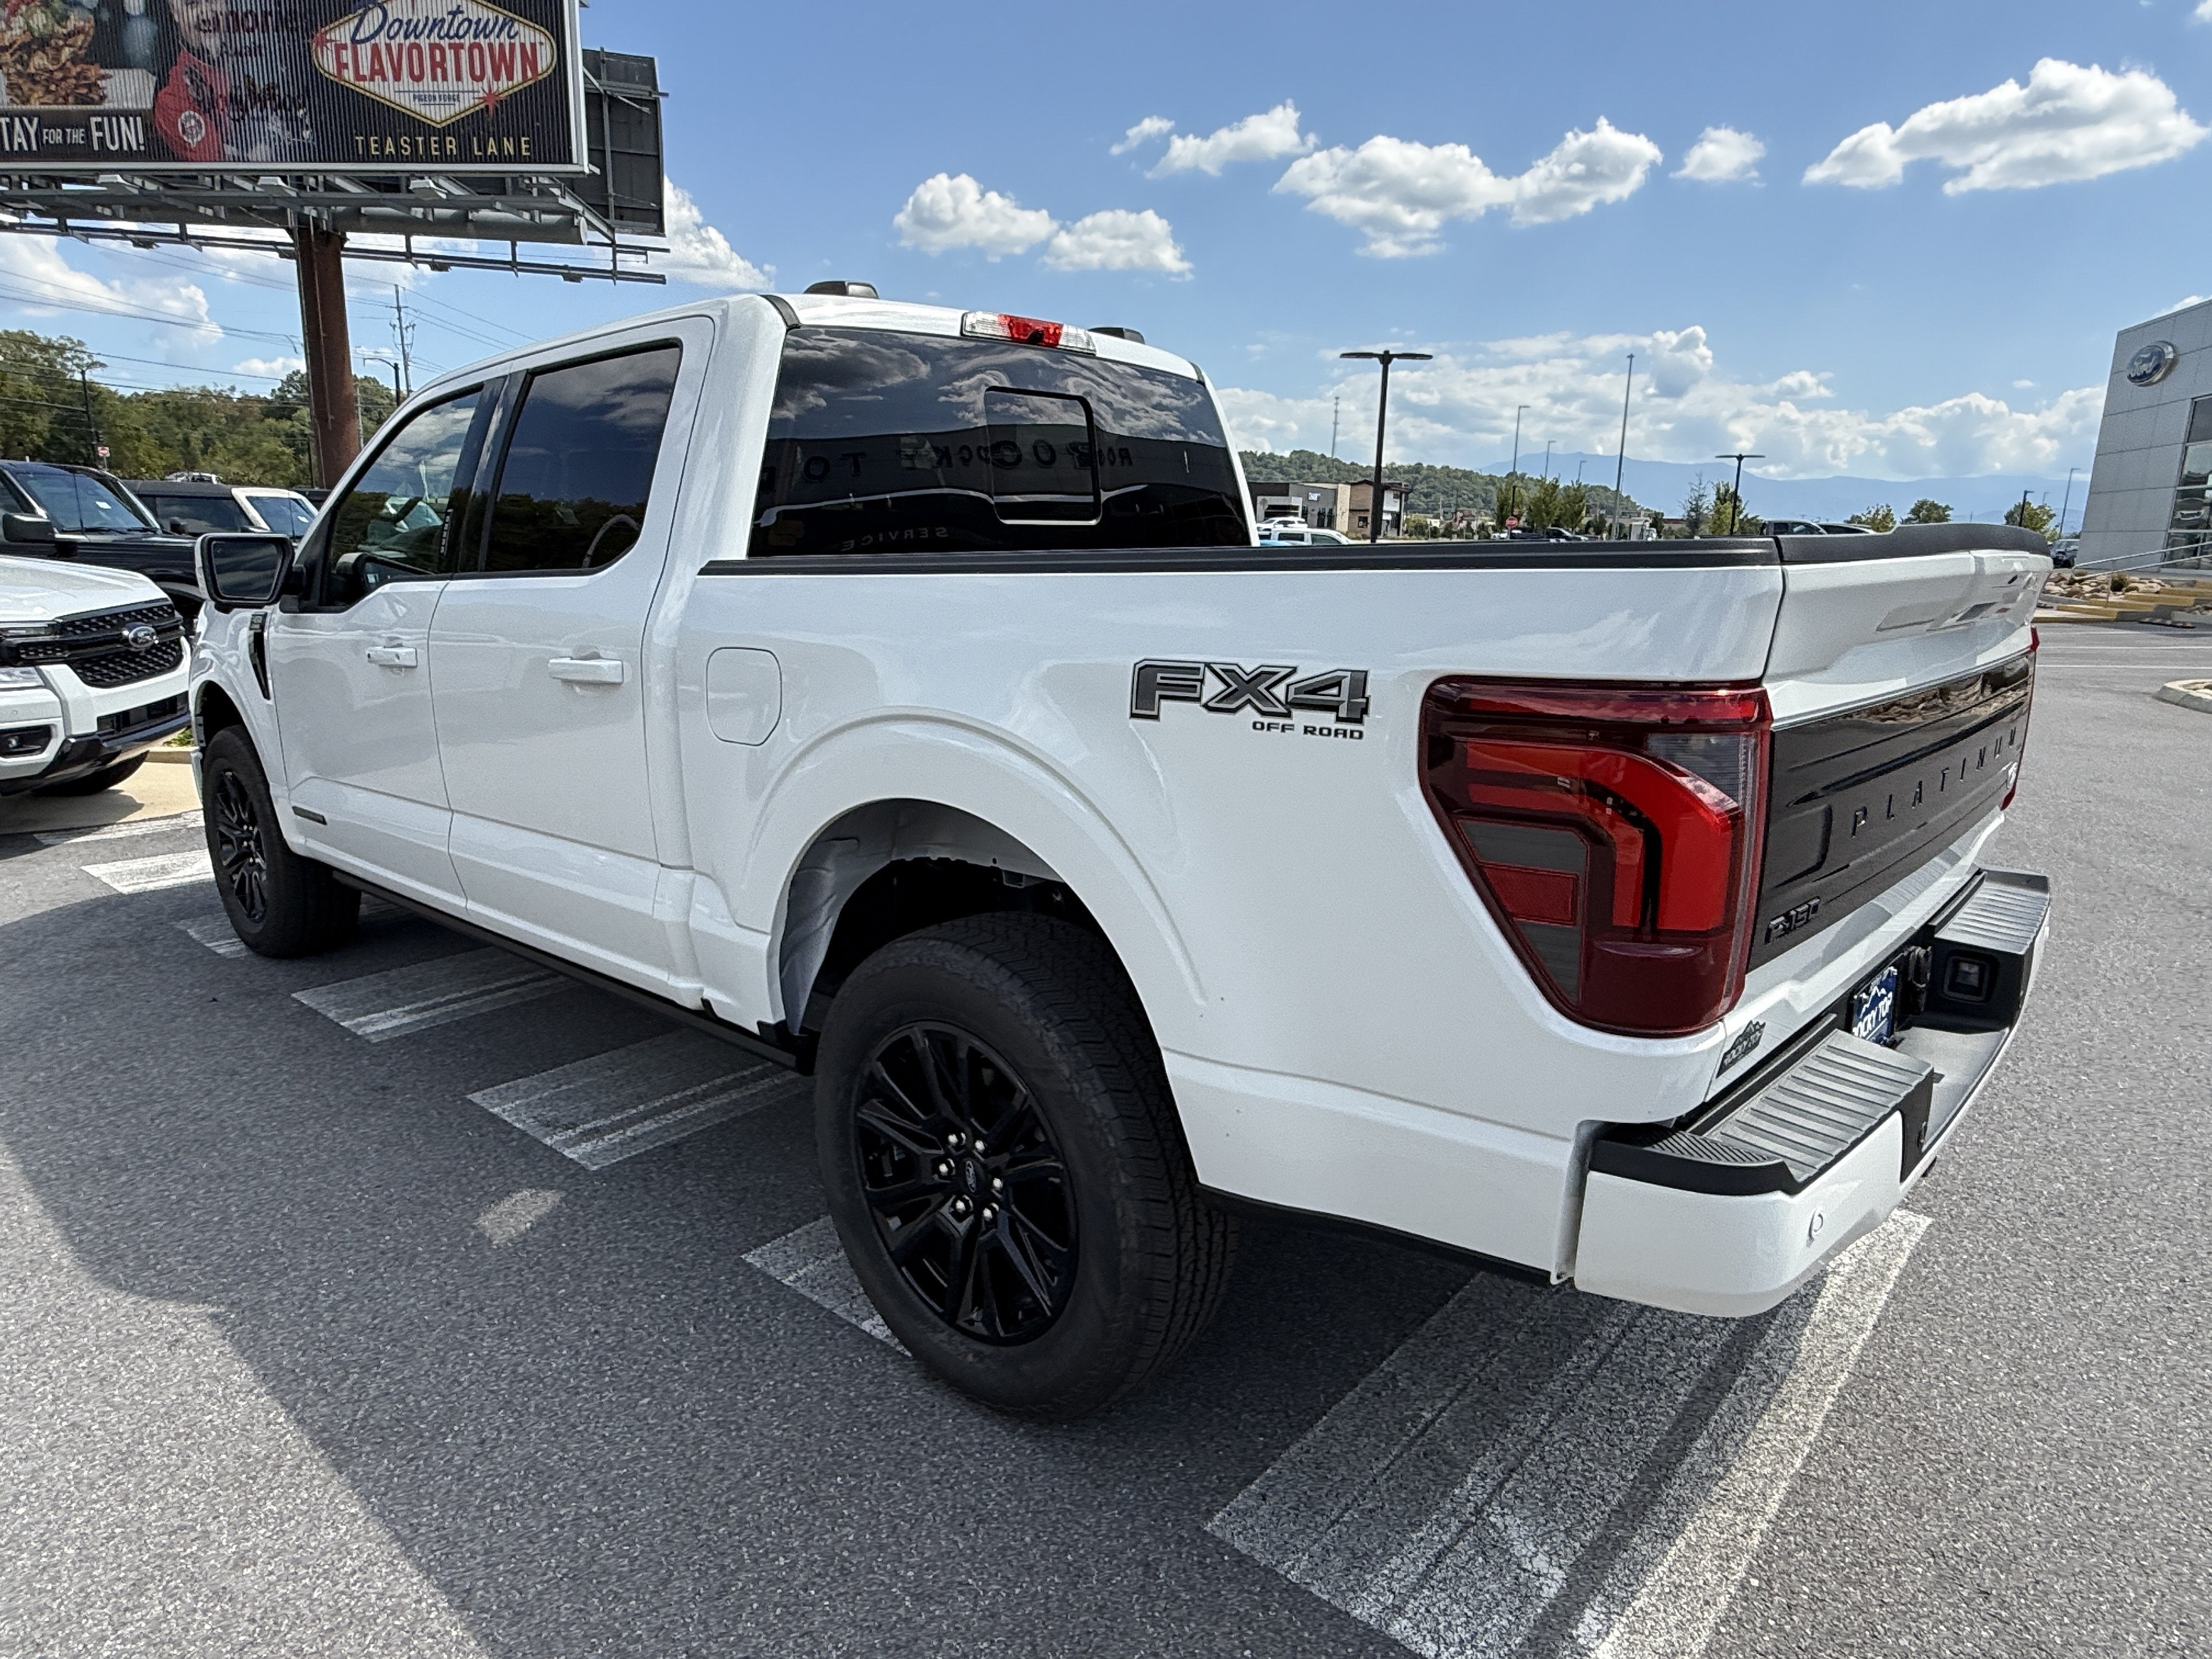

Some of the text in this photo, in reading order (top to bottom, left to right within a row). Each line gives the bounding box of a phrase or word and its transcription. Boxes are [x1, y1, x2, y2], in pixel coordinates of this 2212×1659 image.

[350, 2, 518, 44] Downtown
[334, 42, 539, 82] FLAVORTOWN
[0, 116, 145, 151] TAY FOR THE FUN!
[355, 136, 531, 156] TEASTER LANE
[1129, 658, 1370, 725] FX4
[1252, 720, 1364, 740] OFF ROAD
[1851, 726, 2017, 839] PLATINUM
